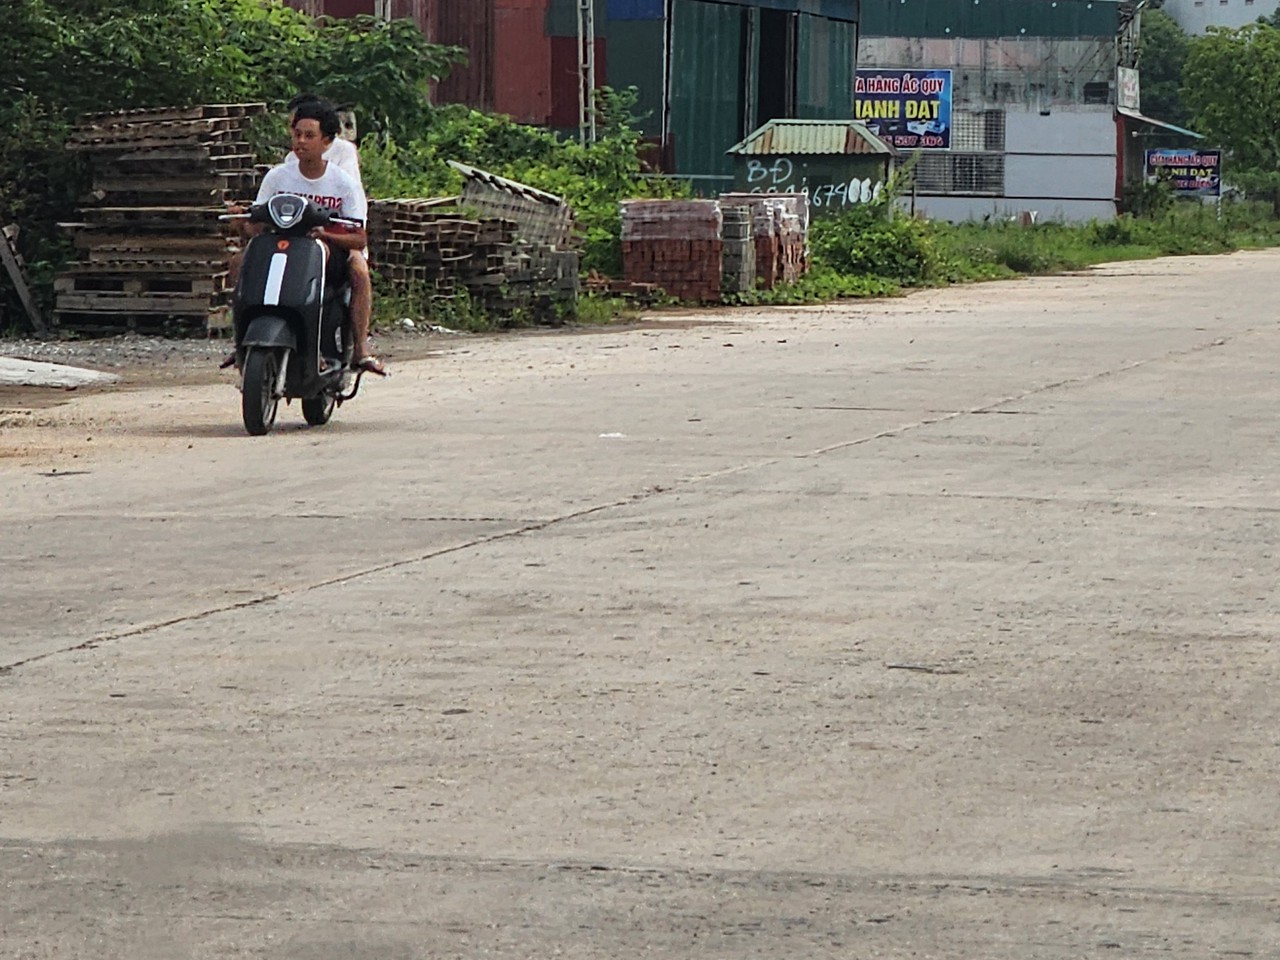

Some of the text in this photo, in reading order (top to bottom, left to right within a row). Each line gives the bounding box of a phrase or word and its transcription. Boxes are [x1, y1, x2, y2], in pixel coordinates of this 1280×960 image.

[902, 73, 919, 93] ẮC
[921, 78, 945, 95] QUY
[905, 100, 940, 122] ĐẠT
